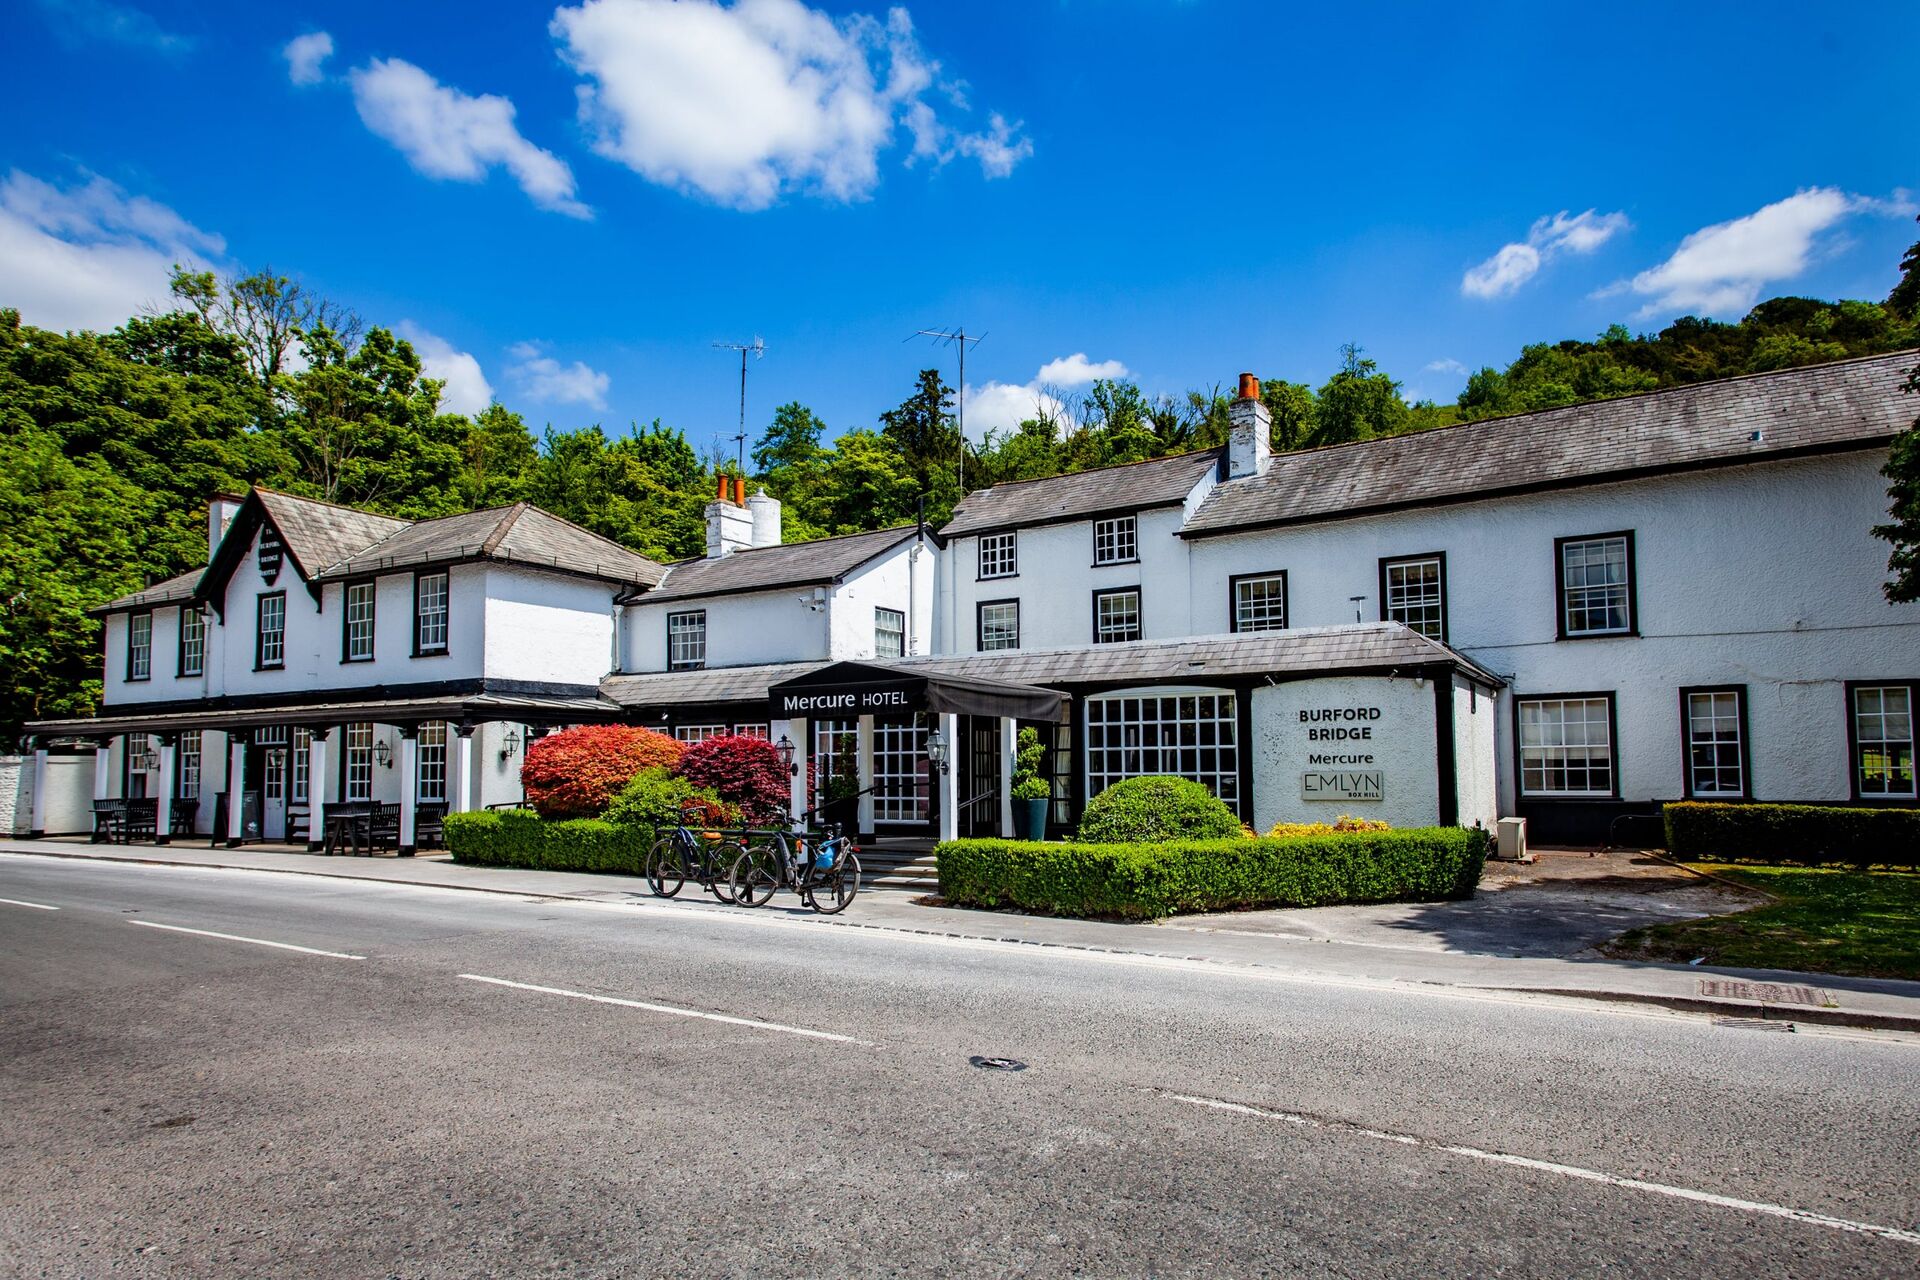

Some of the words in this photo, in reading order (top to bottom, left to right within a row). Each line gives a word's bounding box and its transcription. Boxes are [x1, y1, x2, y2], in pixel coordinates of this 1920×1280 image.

[784, 694, 856, 711] Mercure
[862, 691, 908, 706] HOTEL
[1299, 707, 1381, 722] BURFORD
[1309, 727, 1372, 740] BRIDGE
[1309, 754, 1374, 764] Mercure
[1304, 773, 1379, 791] EMLYN
